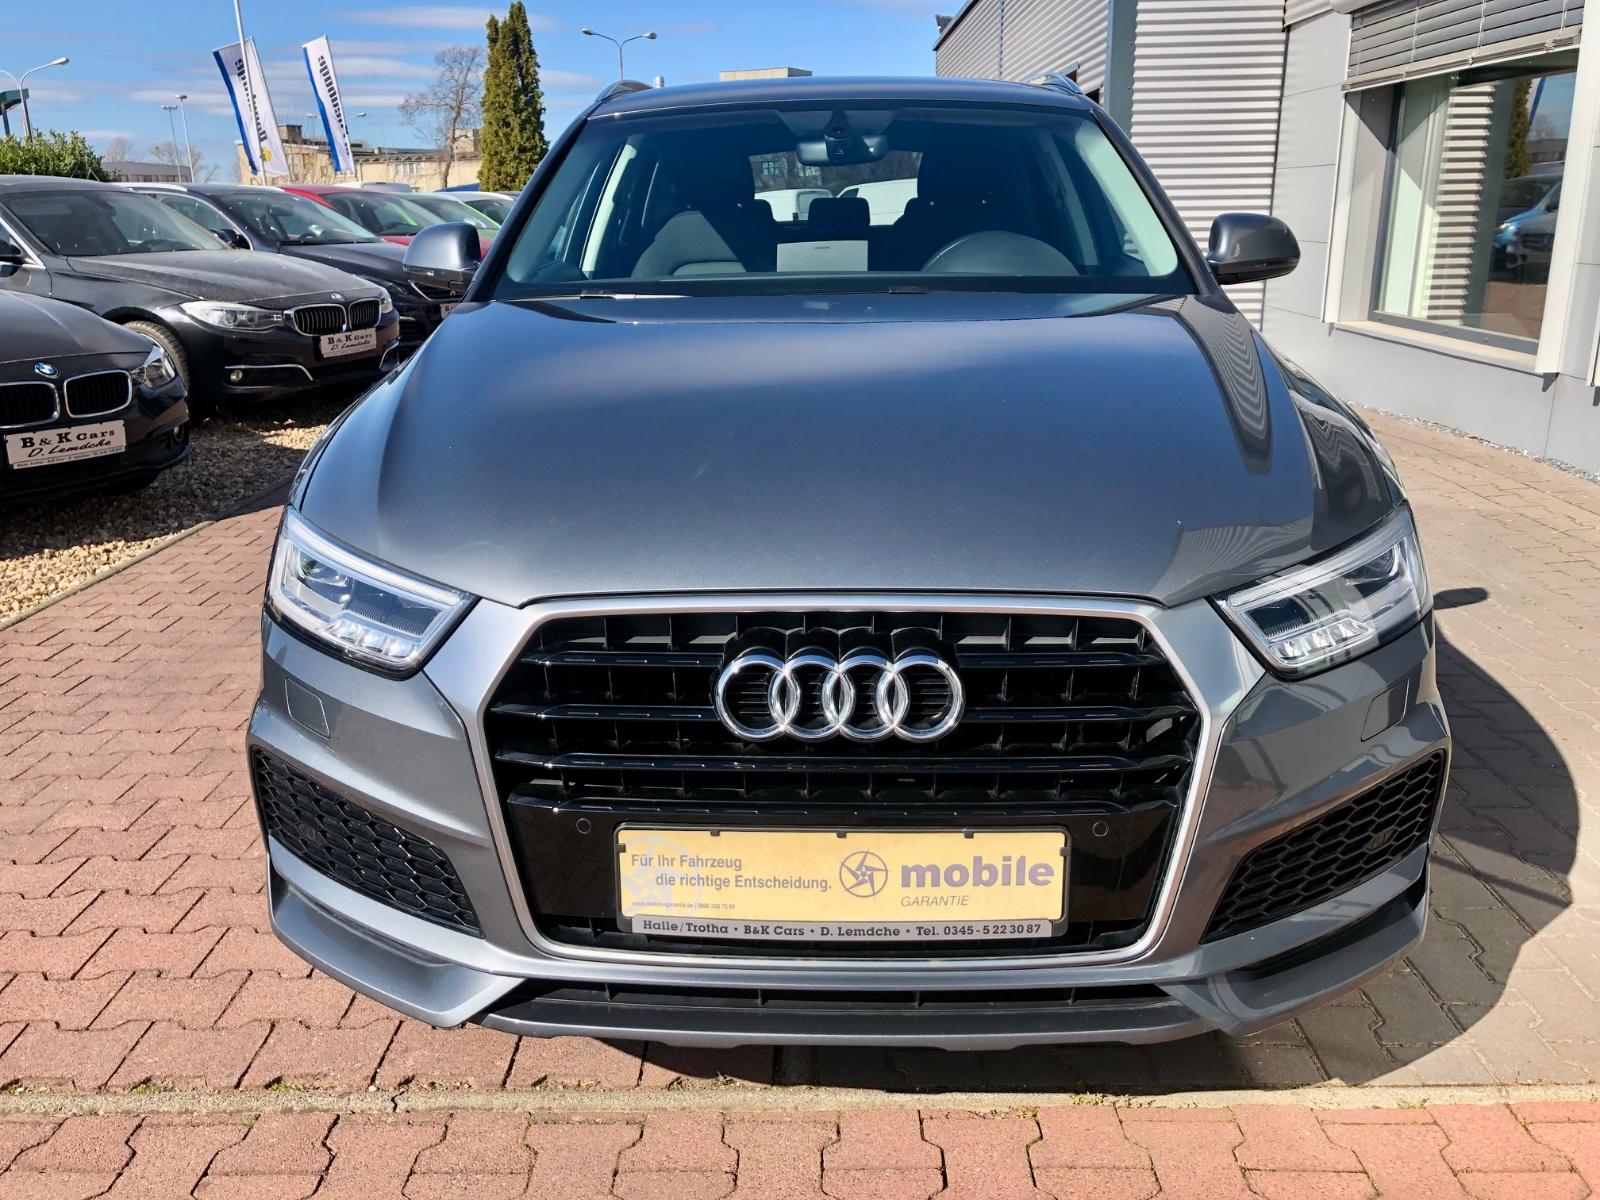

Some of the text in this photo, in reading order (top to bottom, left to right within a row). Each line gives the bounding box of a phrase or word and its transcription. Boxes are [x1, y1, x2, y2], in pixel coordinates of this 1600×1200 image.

[328, 337, 335, 345] B
[20, 437, 36, 448] B
[39, 437, 52, 446] &
[56, 432, 72, 443] K
[28, 448, 45, 458] D.
[631, 854, 743, 871] Für Ihr Fahrzeug
[901, 855, 1055, 888] mobile
[656, 874, 832, 892] die richtige Entscheidung.
[901, 895, 970, 907] GARANTIE
[743, 925, 770, 936] B&K
[773, 925, 805, 936] Cars
[820, 926, 834, 937] D.
[837, 925, 900, 937] Lemdche
[916, 926, 940, 936] Tel.
